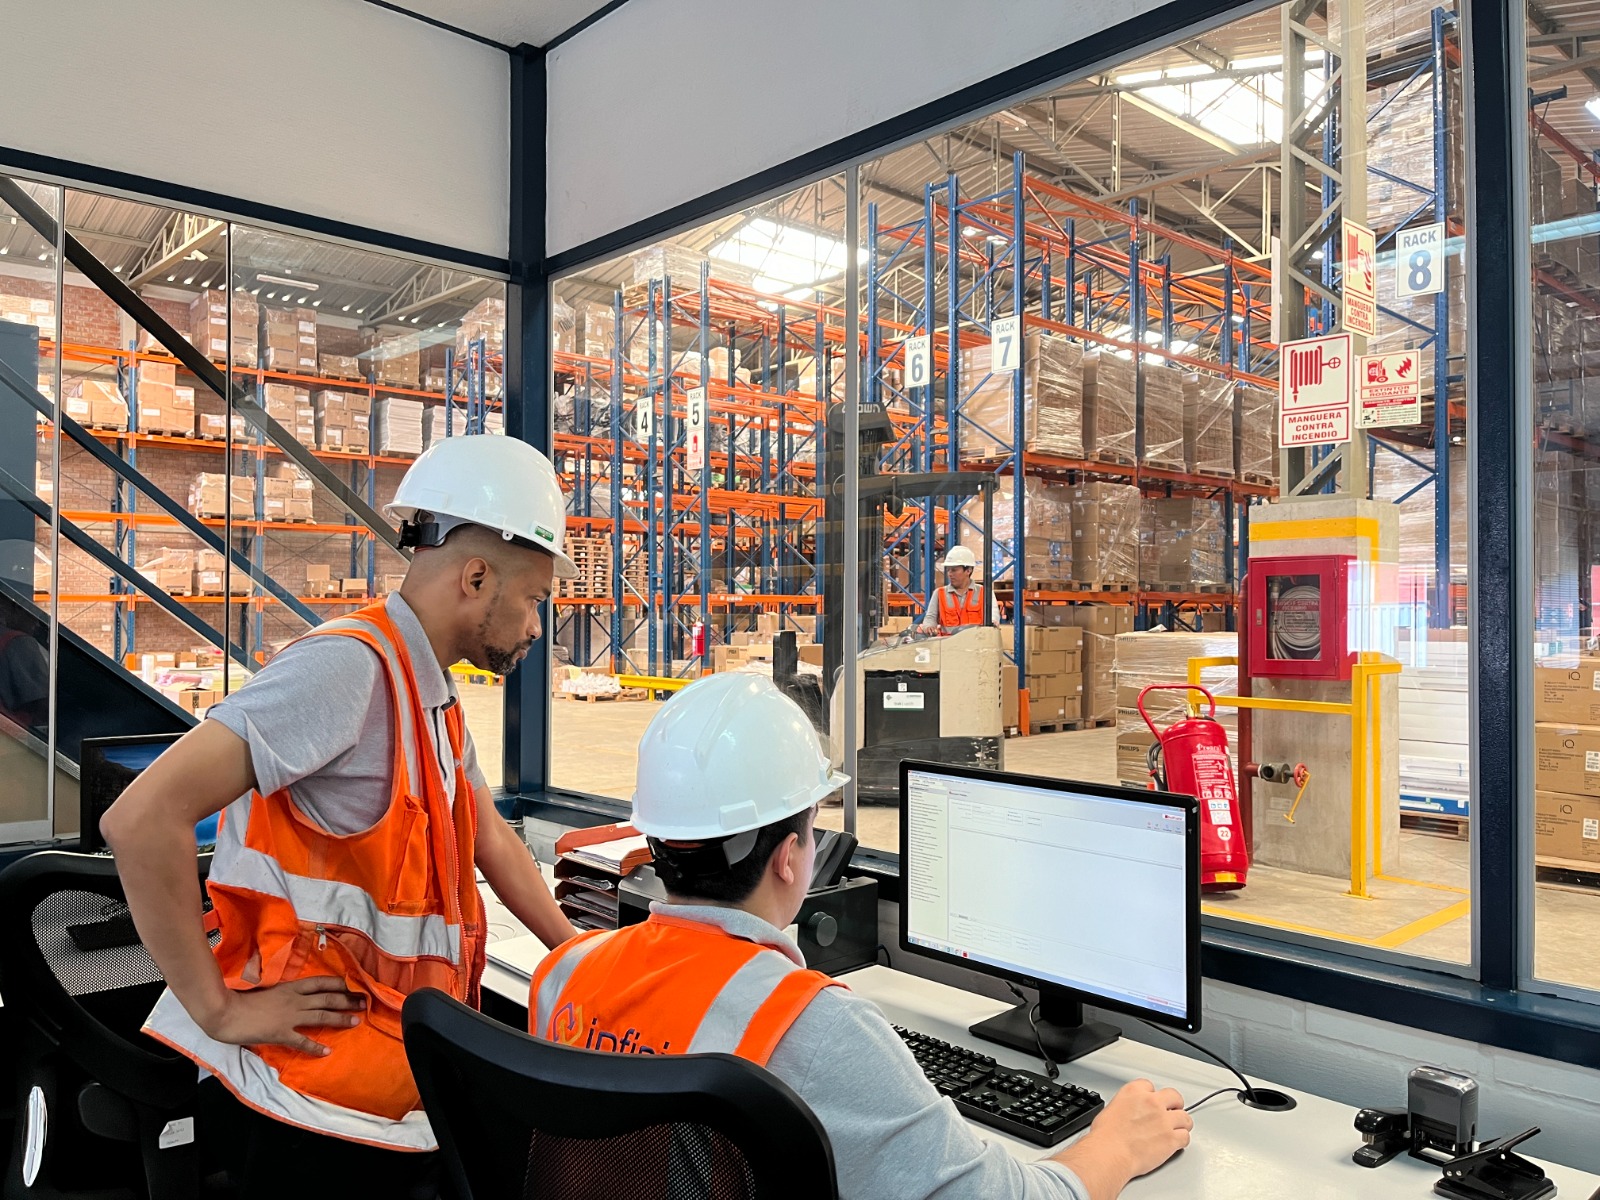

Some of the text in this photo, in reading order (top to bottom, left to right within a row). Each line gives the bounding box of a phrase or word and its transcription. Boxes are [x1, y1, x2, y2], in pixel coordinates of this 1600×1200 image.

[1403, 230, 1436, 248] RACK
[1407, 250, 1432, 291] 8
[1347, 297, 1372, 313] MANGUERA
[1351, 307, 1368, 320] CONTRA
[996, 321, 1015, 334] RACK
[1347, 315, 1371, 331] INCENDIOS
[908, 341, 926, 350] RACK
[998, 335, 1012, 367] 7
[911, 353, 924, 383] 6
[690, 391, 701, 400] RACK
[1369, 385, 1410, 393] EXTINTOR
[692, 402, 700, 426] 5
[1288, 412, 1342, 424] MANGUERA
[641, 411, 648, 432] 4
[1295, 422, 1334, 432] CONTRA
[1291, 430, 1338, 441] INCENDIO
[1118, 744, 1140, 752] PHILIPS
[1220, 830, 1230, 838] 22
